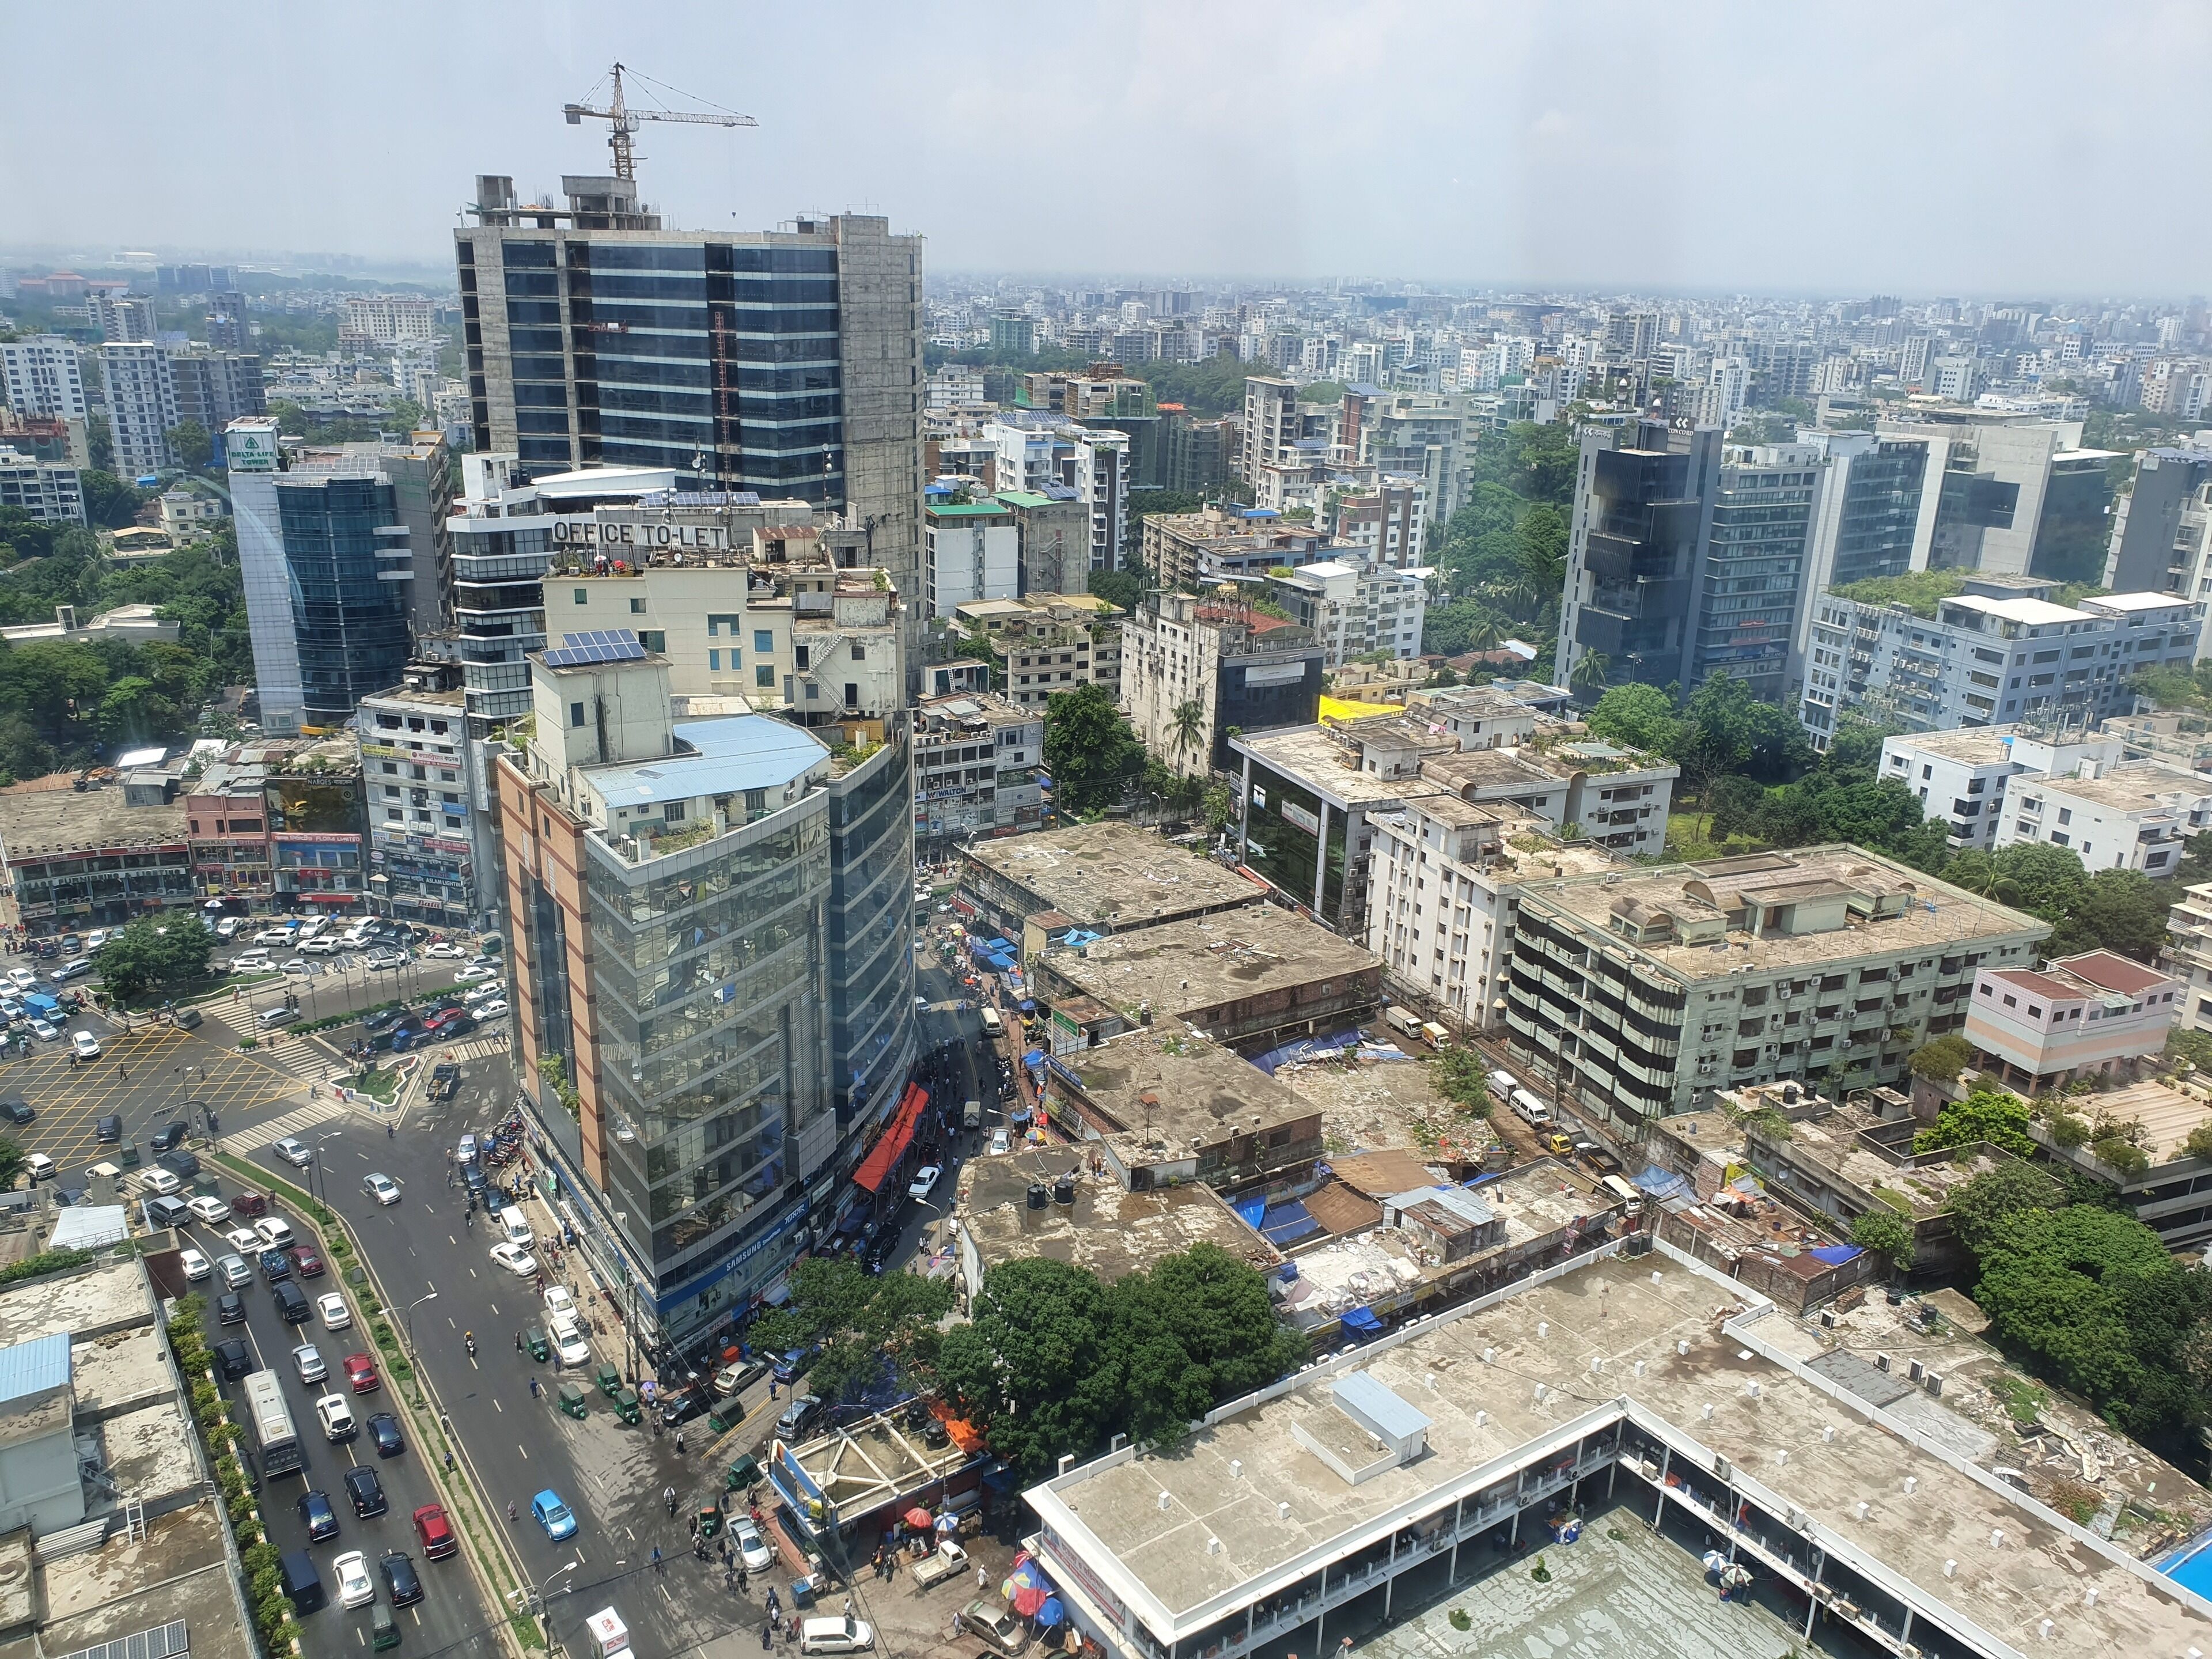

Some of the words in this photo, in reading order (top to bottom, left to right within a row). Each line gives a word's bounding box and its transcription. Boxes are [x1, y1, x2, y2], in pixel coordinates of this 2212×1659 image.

[1668, 429, 1694, 437] CONCORD
[554, 521, 634, 543] OFFICE
[938, 787, 966, 797] WALTON
[418, 900, 440, 908] Bata
[726, 1241, 762, 1272] SAMSUNG
